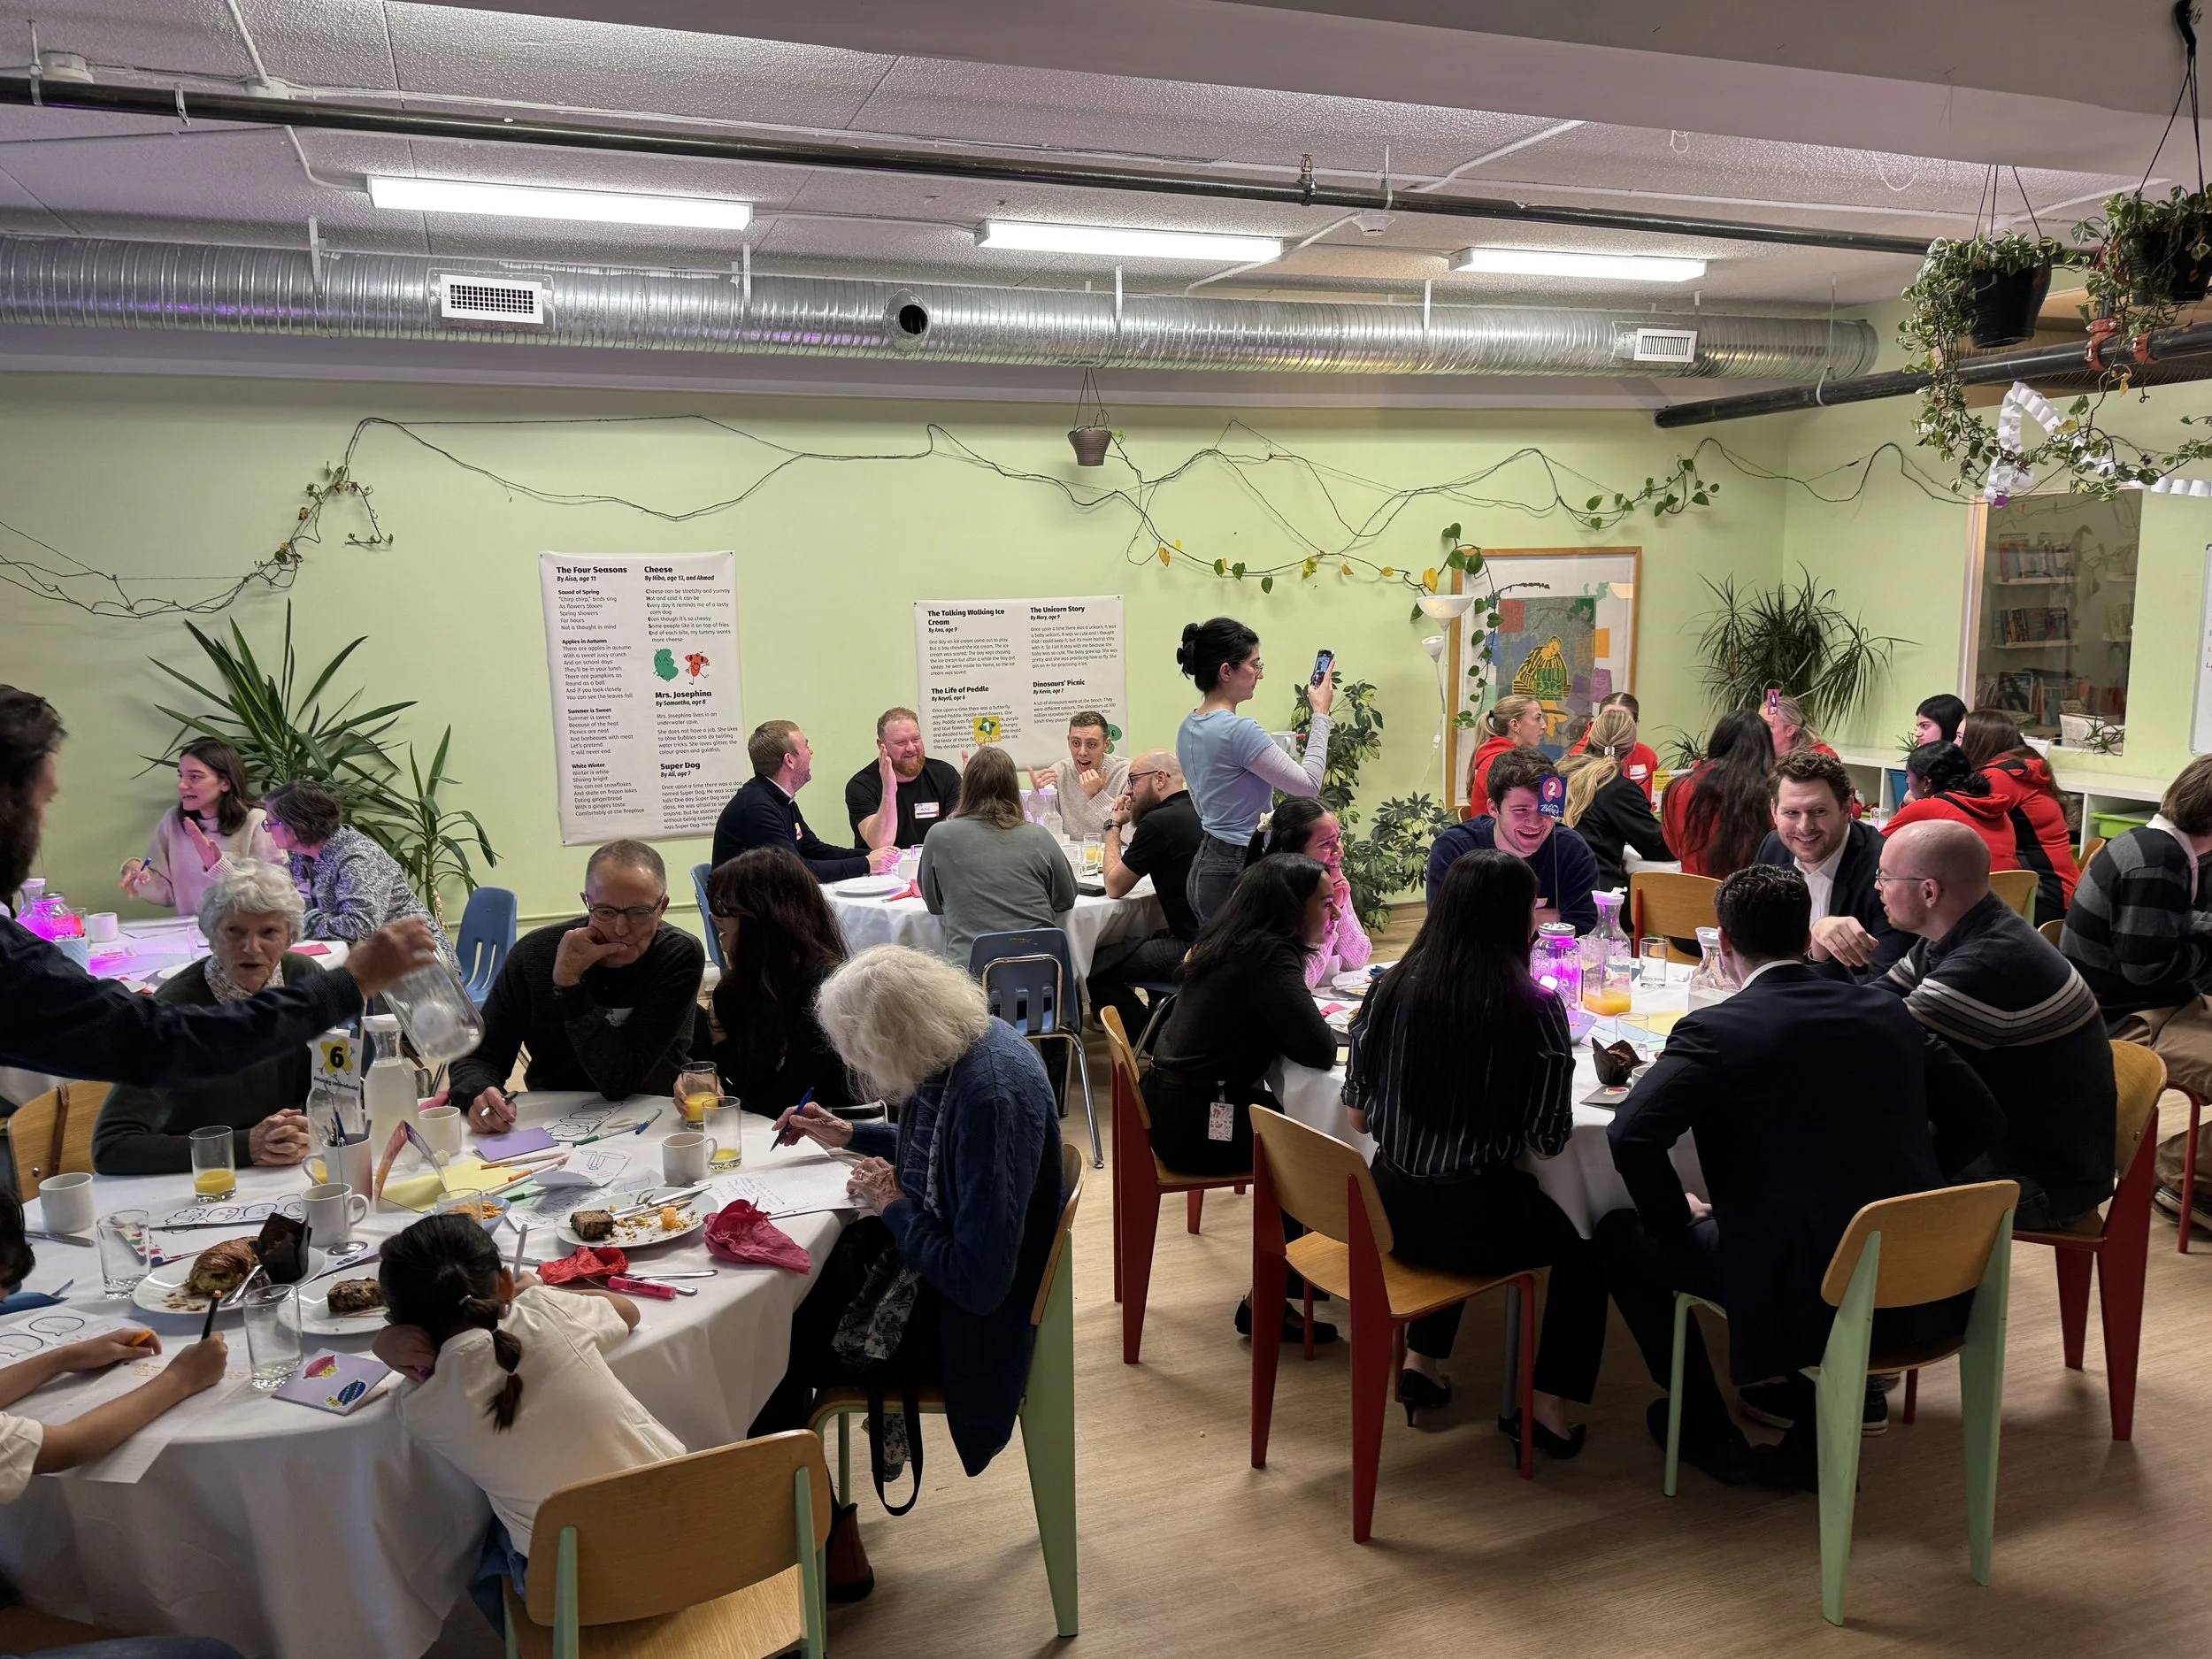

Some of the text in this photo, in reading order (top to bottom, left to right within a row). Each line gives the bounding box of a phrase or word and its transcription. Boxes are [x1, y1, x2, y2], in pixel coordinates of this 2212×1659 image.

[941, 609, 966, 618] Talking
[967, 608, 995, 618] Walking
[673, 690, 712, 699] Josephina
[983, 721, 990, 732] 1
[660, 762, 701, 772] Super Dog
[1548, 781, 1556, 796] 2
[329, 1046, 345, 1069] 6
